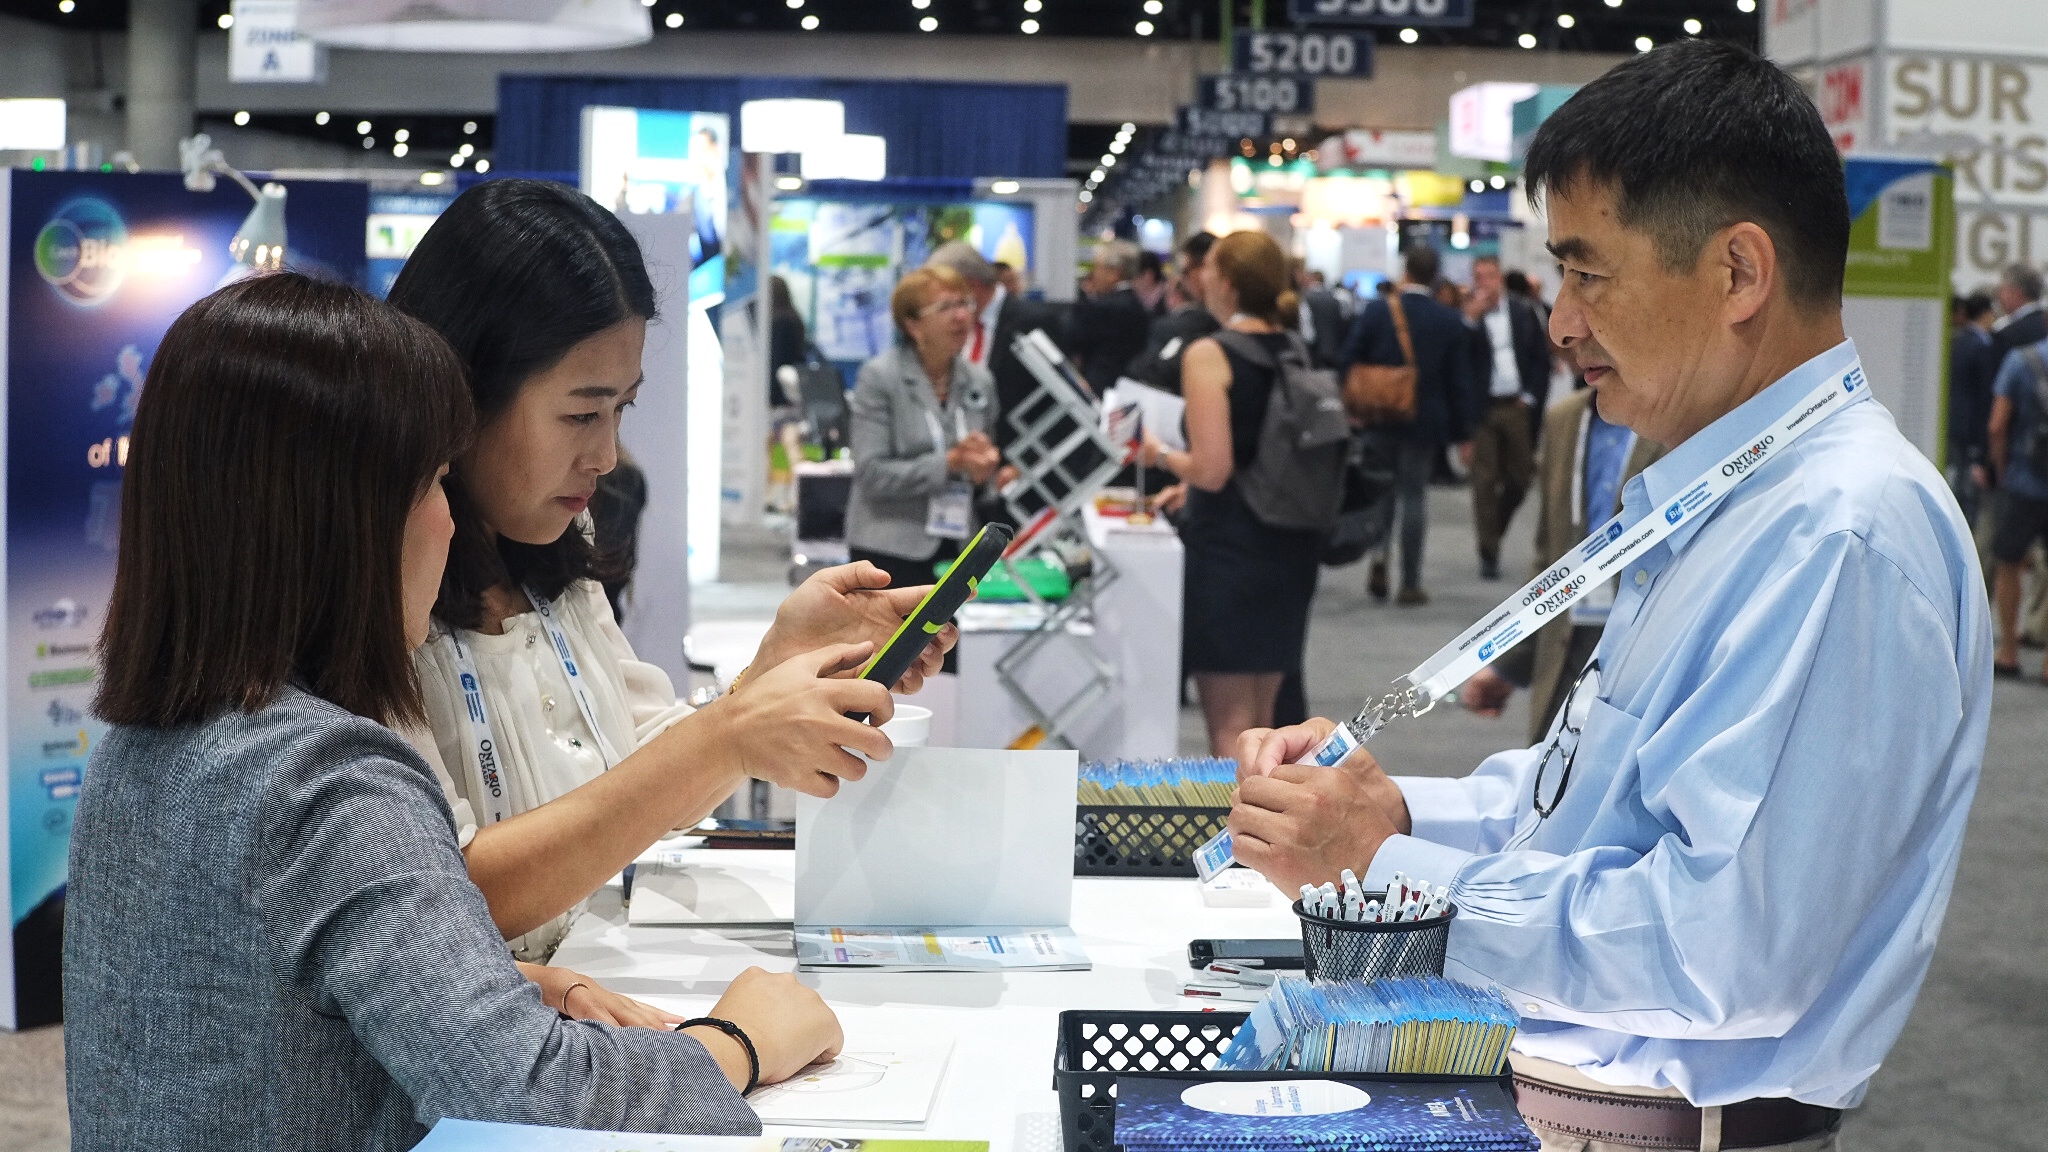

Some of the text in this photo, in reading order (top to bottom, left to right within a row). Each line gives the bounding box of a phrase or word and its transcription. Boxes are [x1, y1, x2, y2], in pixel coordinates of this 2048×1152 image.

[1249, 34, 1356, 73] 5200
[1214, 79, 1298, 111] 5100
[1896, 61, 2029, 123] SUR
[88, 437, 112, 468] of
[1722, 435, 1774, 477] ONTARIO
[1737, 451, 1767, 474] CANADA
[1522, 566, 1570, 606] ONTARIO
[1531, 570, 1557, 592] CANADA
[1534, 574, 1586, 615] ONTARIO
[1548, 590, 1578, 613] CANADA
[478, 752, 490, 786] CANADA
[480, 739, 502, 798] ONTARIO
